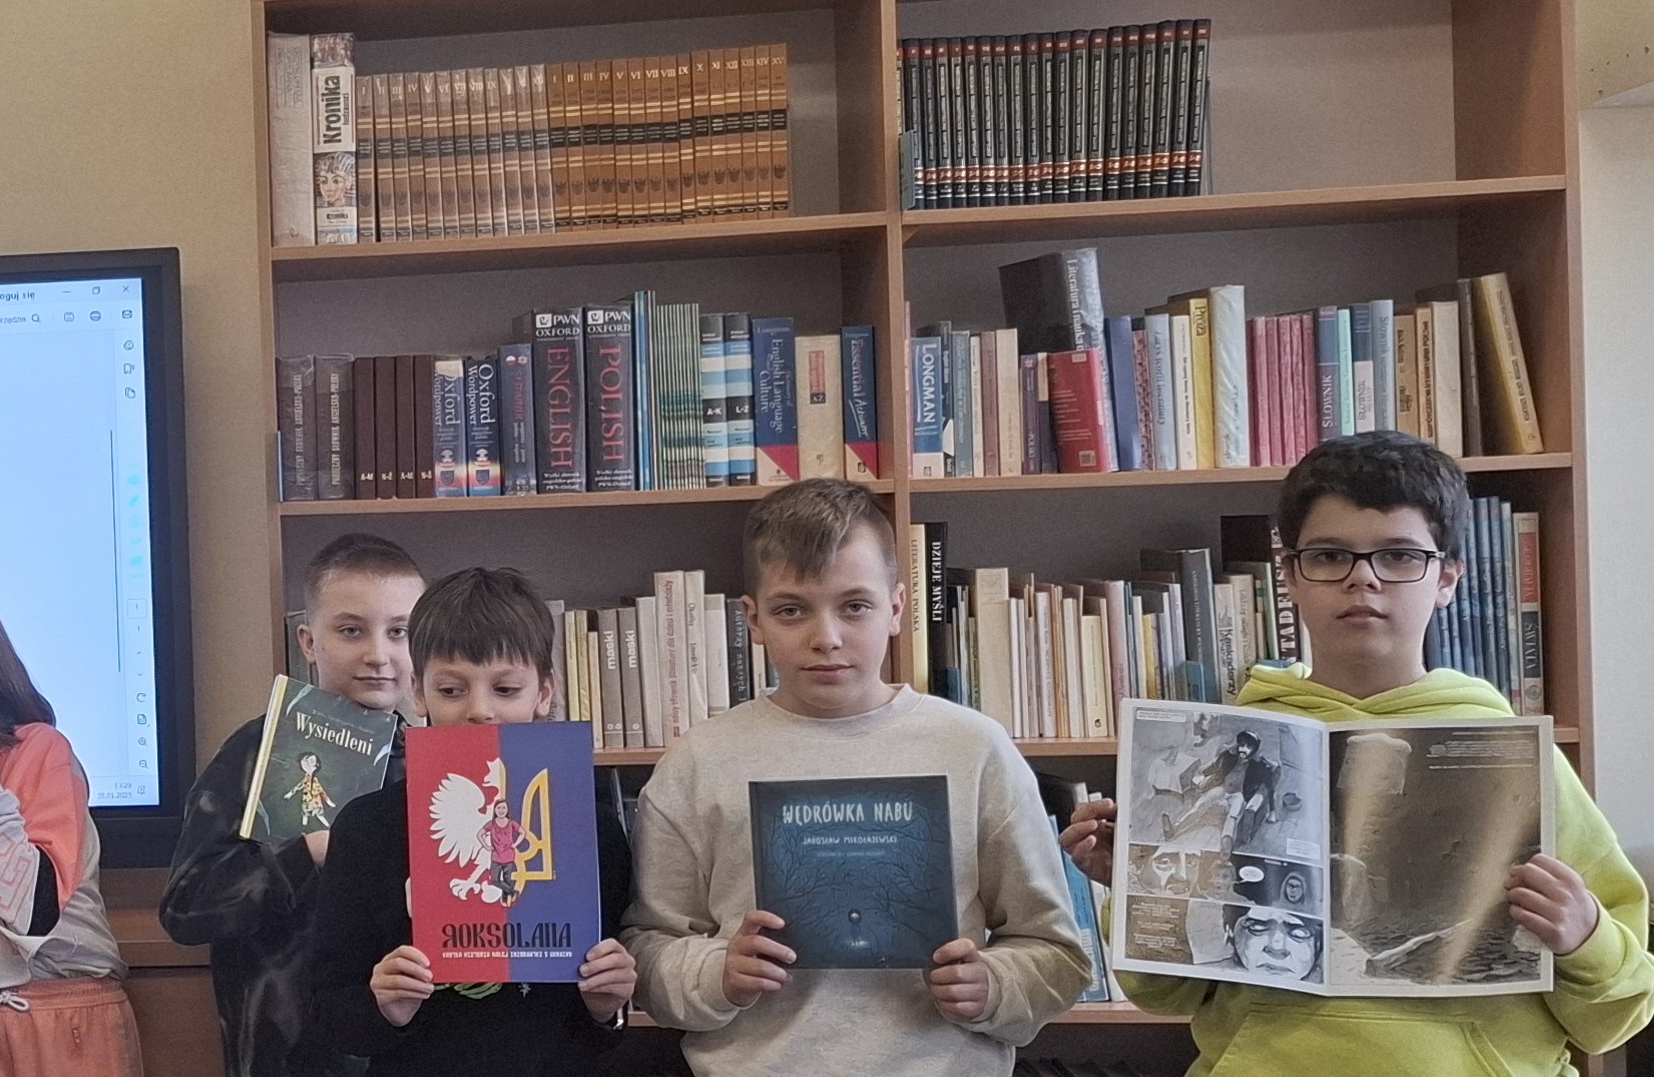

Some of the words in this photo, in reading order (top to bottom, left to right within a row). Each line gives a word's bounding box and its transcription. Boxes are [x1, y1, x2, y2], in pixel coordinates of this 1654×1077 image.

[321, 75, 342, 144] Kronika
[22, 292, 35, 301] się
[1066, 259, 1084, 309] Literatura
[536, 326, 580, 337] OXFORD
[553, 313, 580, 326] PWN
[587, 323, 631, 333] OXFORD
[605, 310, 631, 323] PWN
[767, 338, 784, 378] English
[851, 338, 866, 398] Essential
[466, 364, 478, 427] Wordpower
[477, 363, 496, 430] Oxford
[599, 344, 625, 462] POLISH
[759, 371, 772, 413] Culture
[922, 343, 935, 423] LONGMAN
[1322, 374, 1334, 428] SŁOWNIK
[547, 346, 573, 467] ENGLISH
[706, 407, 722, 416] A-K
[735, 405, 749, 413] L-Z
[769, 380, 784, 433] Language
[910, 539, 919, 594] LITERATURA
[931, 541, 942, 583] DZIEJE
[912, 598, 920, 632] POLSKA
[932, 586, 945, 622] MYŚLI
[607, 630, 615, 670] maski
[627, 630, 637, 668] maski
[1525, 621, 1539, 669] ŚWIATA
[296, 711, 374, 756] Wysiedleni
[782, 801, 865, 826] WĘDRÓWKA
[874, 801, 914, 822] NABU
[803, 836, 840, 845] JAROSŁAW
